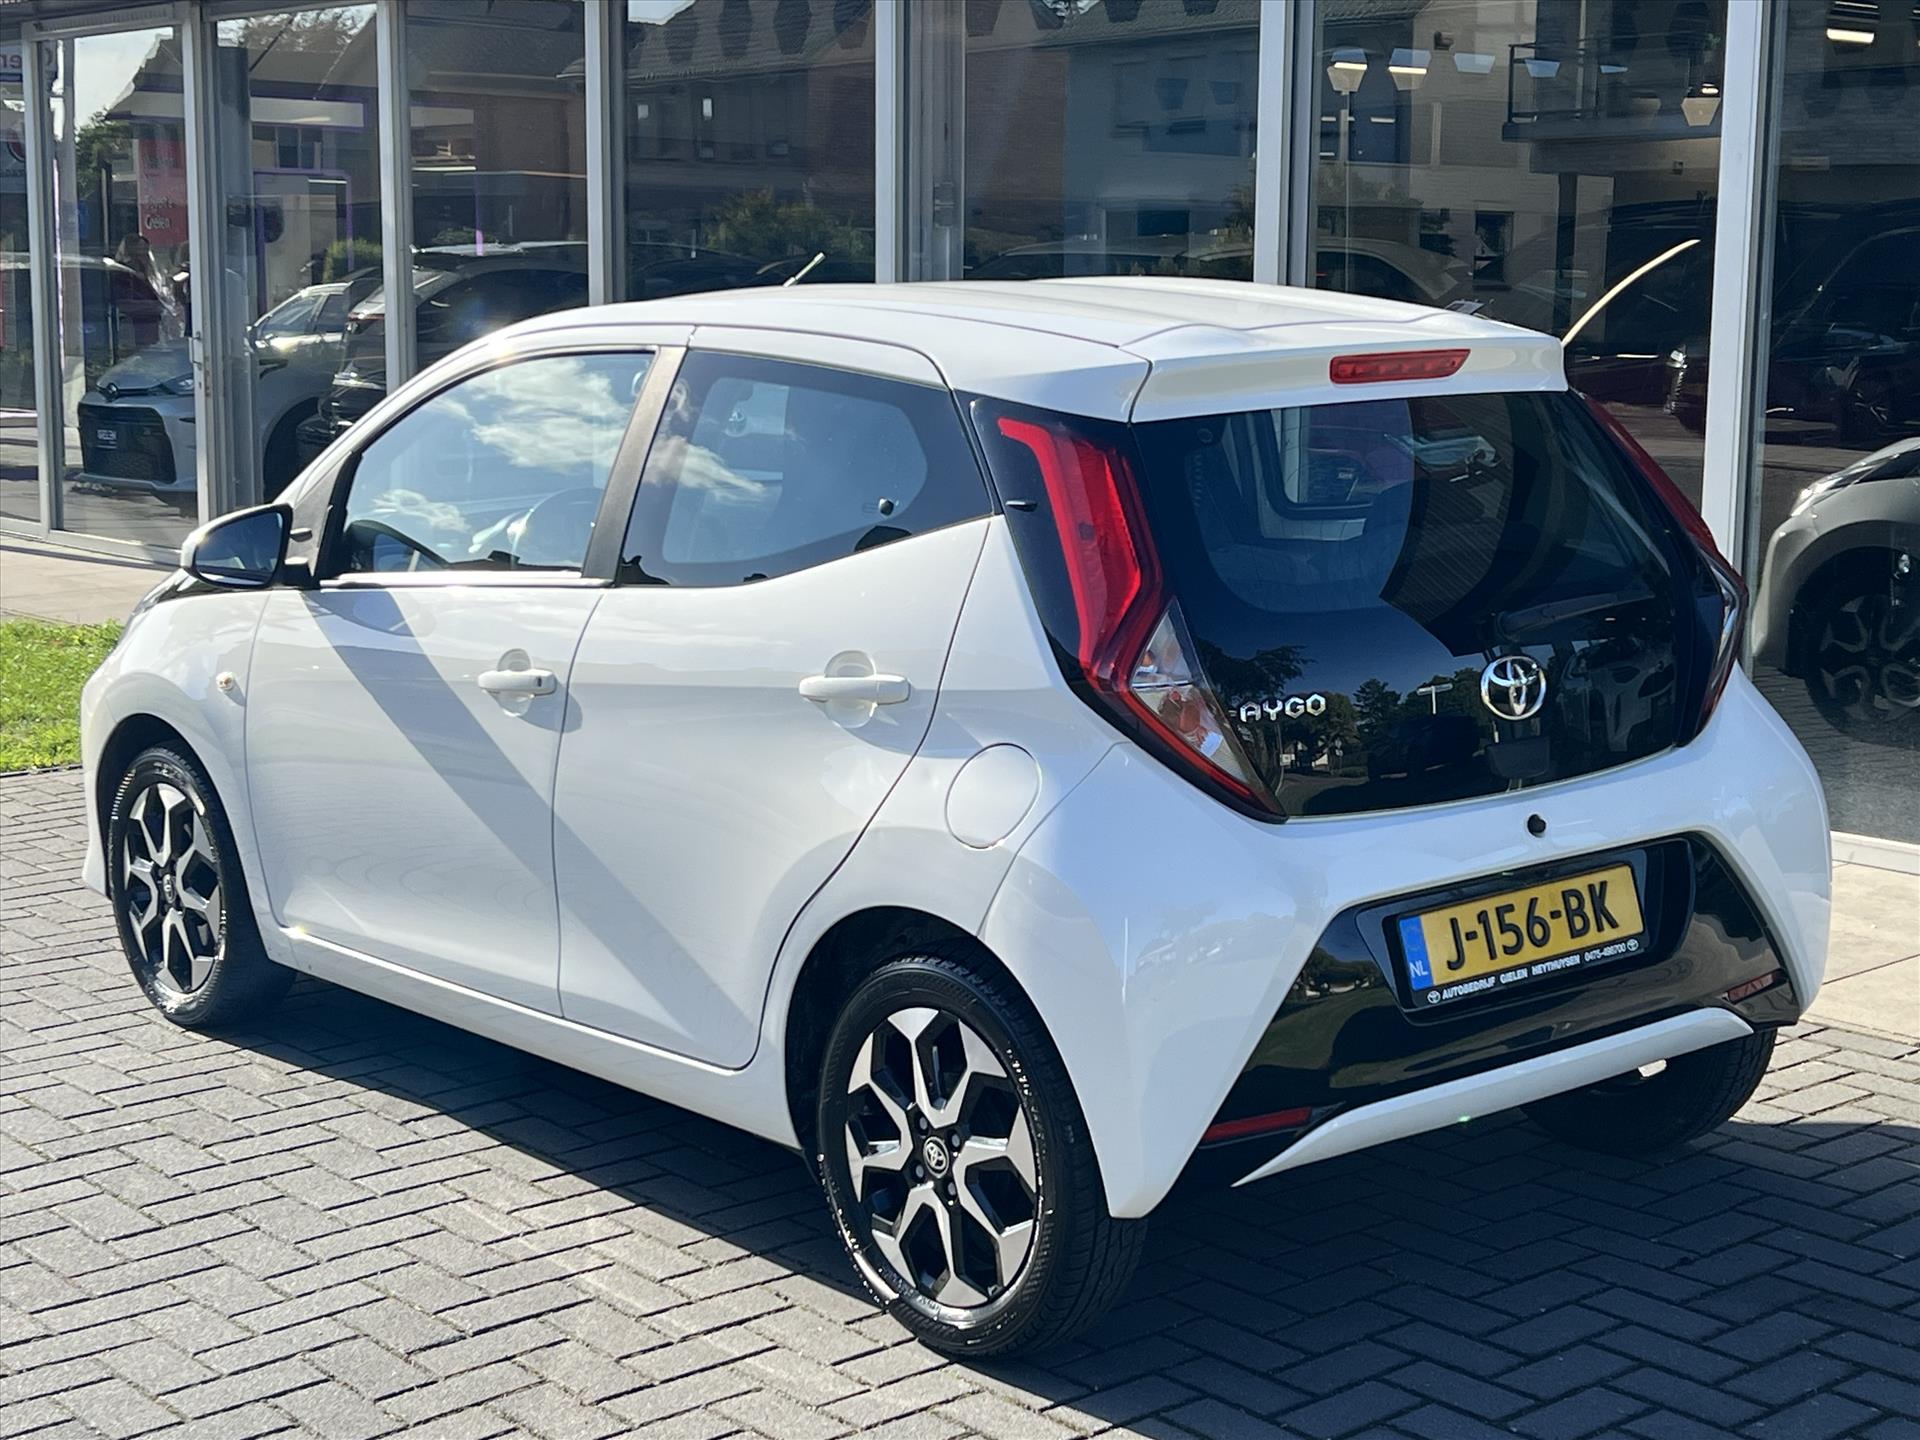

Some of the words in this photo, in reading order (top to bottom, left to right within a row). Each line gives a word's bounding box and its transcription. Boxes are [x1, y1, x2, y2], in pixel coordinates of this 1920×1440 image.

[1240, 693, 1326, 722] AYGO
[1446, 880, 1619, 971] J-156-BK
[1410, 959, 1428, 978] NL
[1441, 976, 1497, 1000] AUTOBEDRIJF
[1500, 967, 1529, 985] GIELEN
